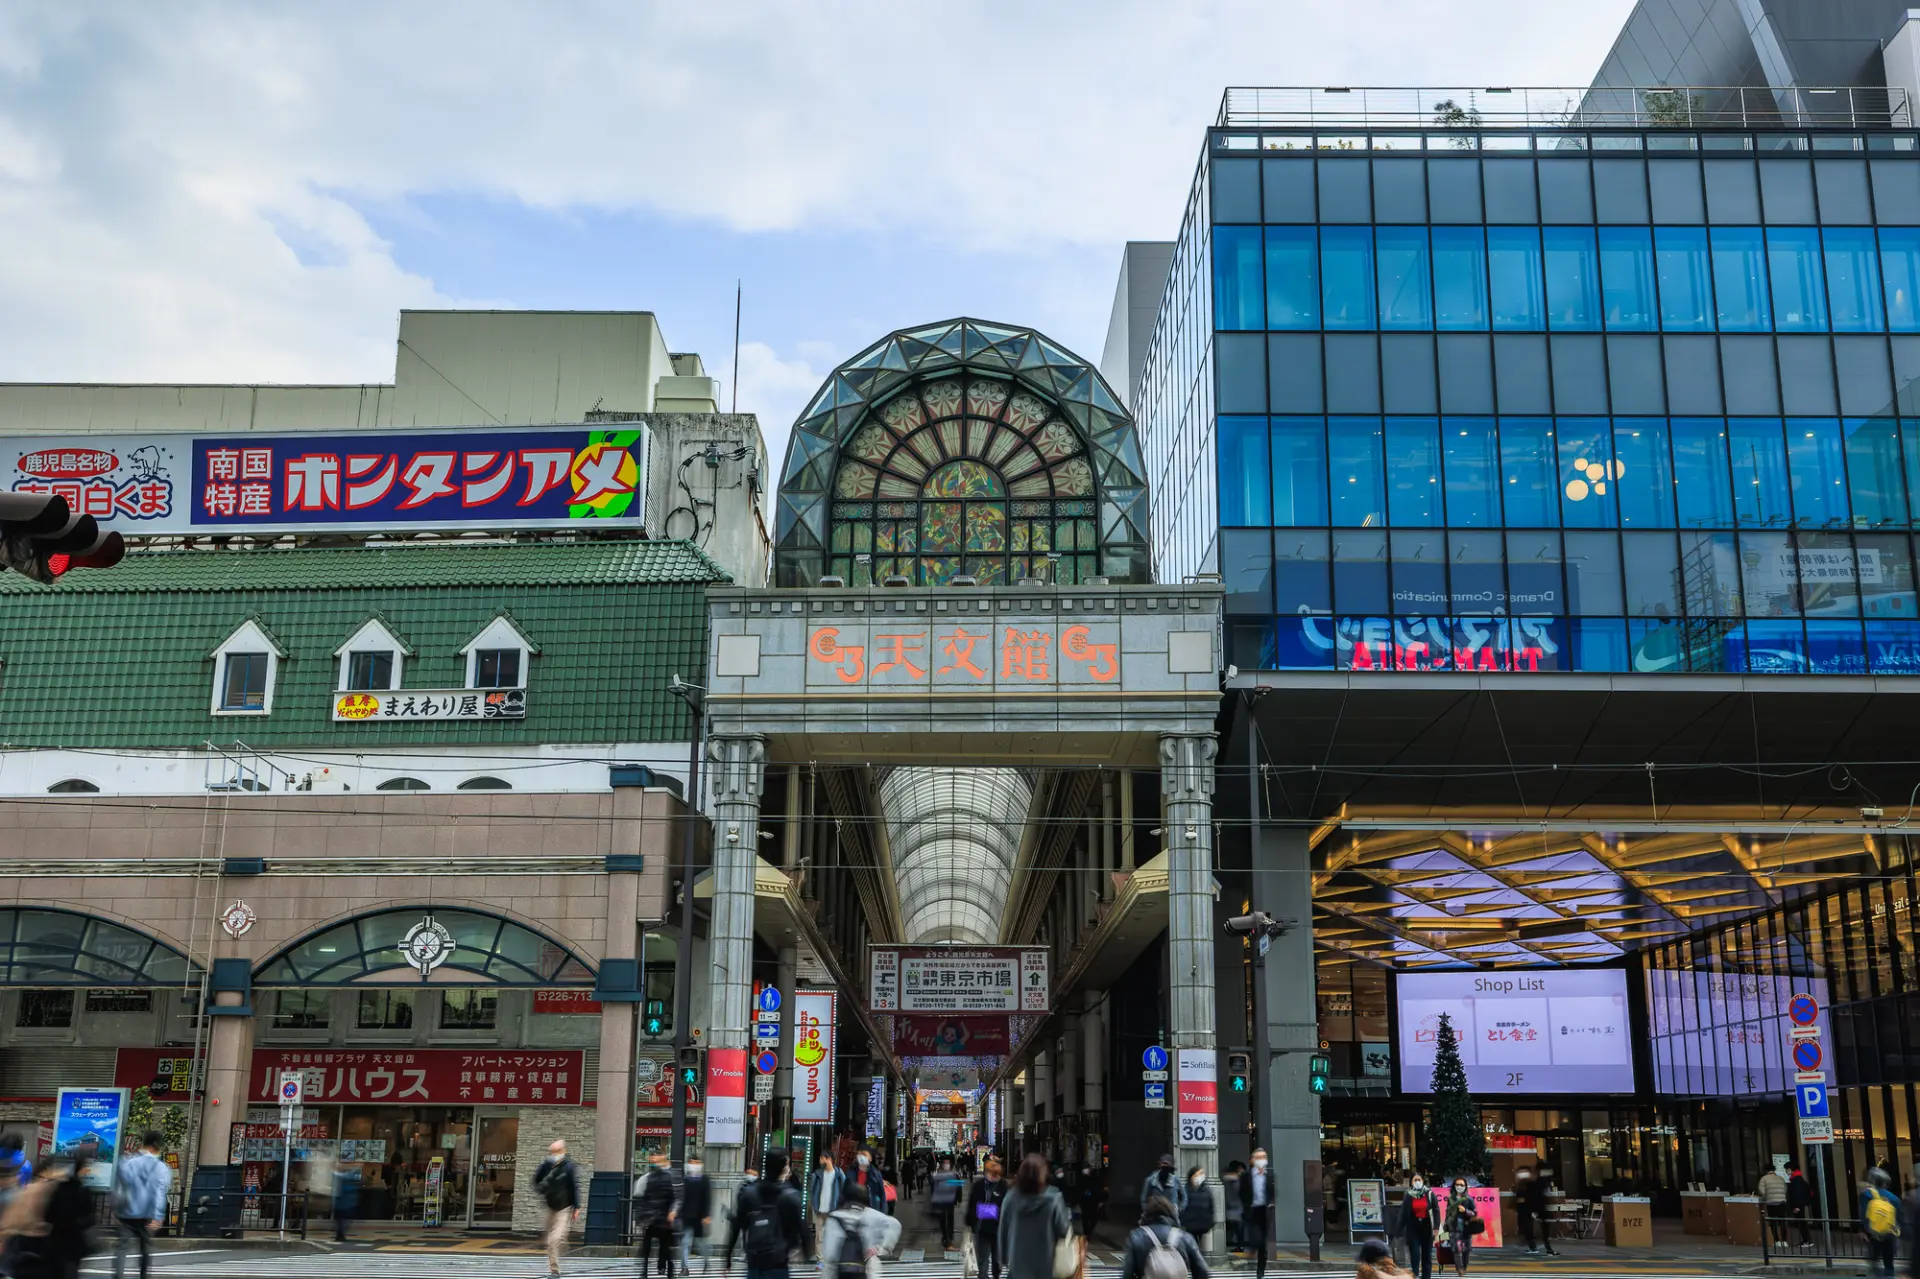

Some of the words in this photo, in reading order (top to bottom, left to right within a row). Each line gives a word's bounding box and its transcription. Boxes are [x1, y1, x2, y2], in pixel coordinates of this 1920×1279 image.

[25, 454, 112, 472] 鹿児島名物
[206, 448, 273, 481] 南国
[284, 447, 637, 512] ボンタンアメ
[205, 483, 271, 516] 特産
[871, 627, 1051, 680] 天文館
[384, 695, 479, 716] まえわり屋
[940, 970, 1011, 987] 東京市場
[1474, 978, 1513, 994] Shop
[1518, 978, 1545, 990] List
[1415, 1029, 1463, 1042] ピエロ
[1487, 1028, 1538, 1041] とし食堂
[281, 1054, 365, 1063] 不動産情報プラザ
[372, 1054, 415, 1063] 天文館店
[462, 1056, 569, 1067] アパート・マンション
[261, 1067, 430, 1099] 川商ハウス
[460, 1072, 568, 1083] 貸事務所・貸店舗
[1506, 1073, 1524, 1086] 2F
[459, 1087, 567, 1099] 不動産売買
[1804, 1087, 1822, 1114] P
[867, 1088, 876, 1132] ANNICHI
[1622, 1218, 1643, 1227] BYZE
